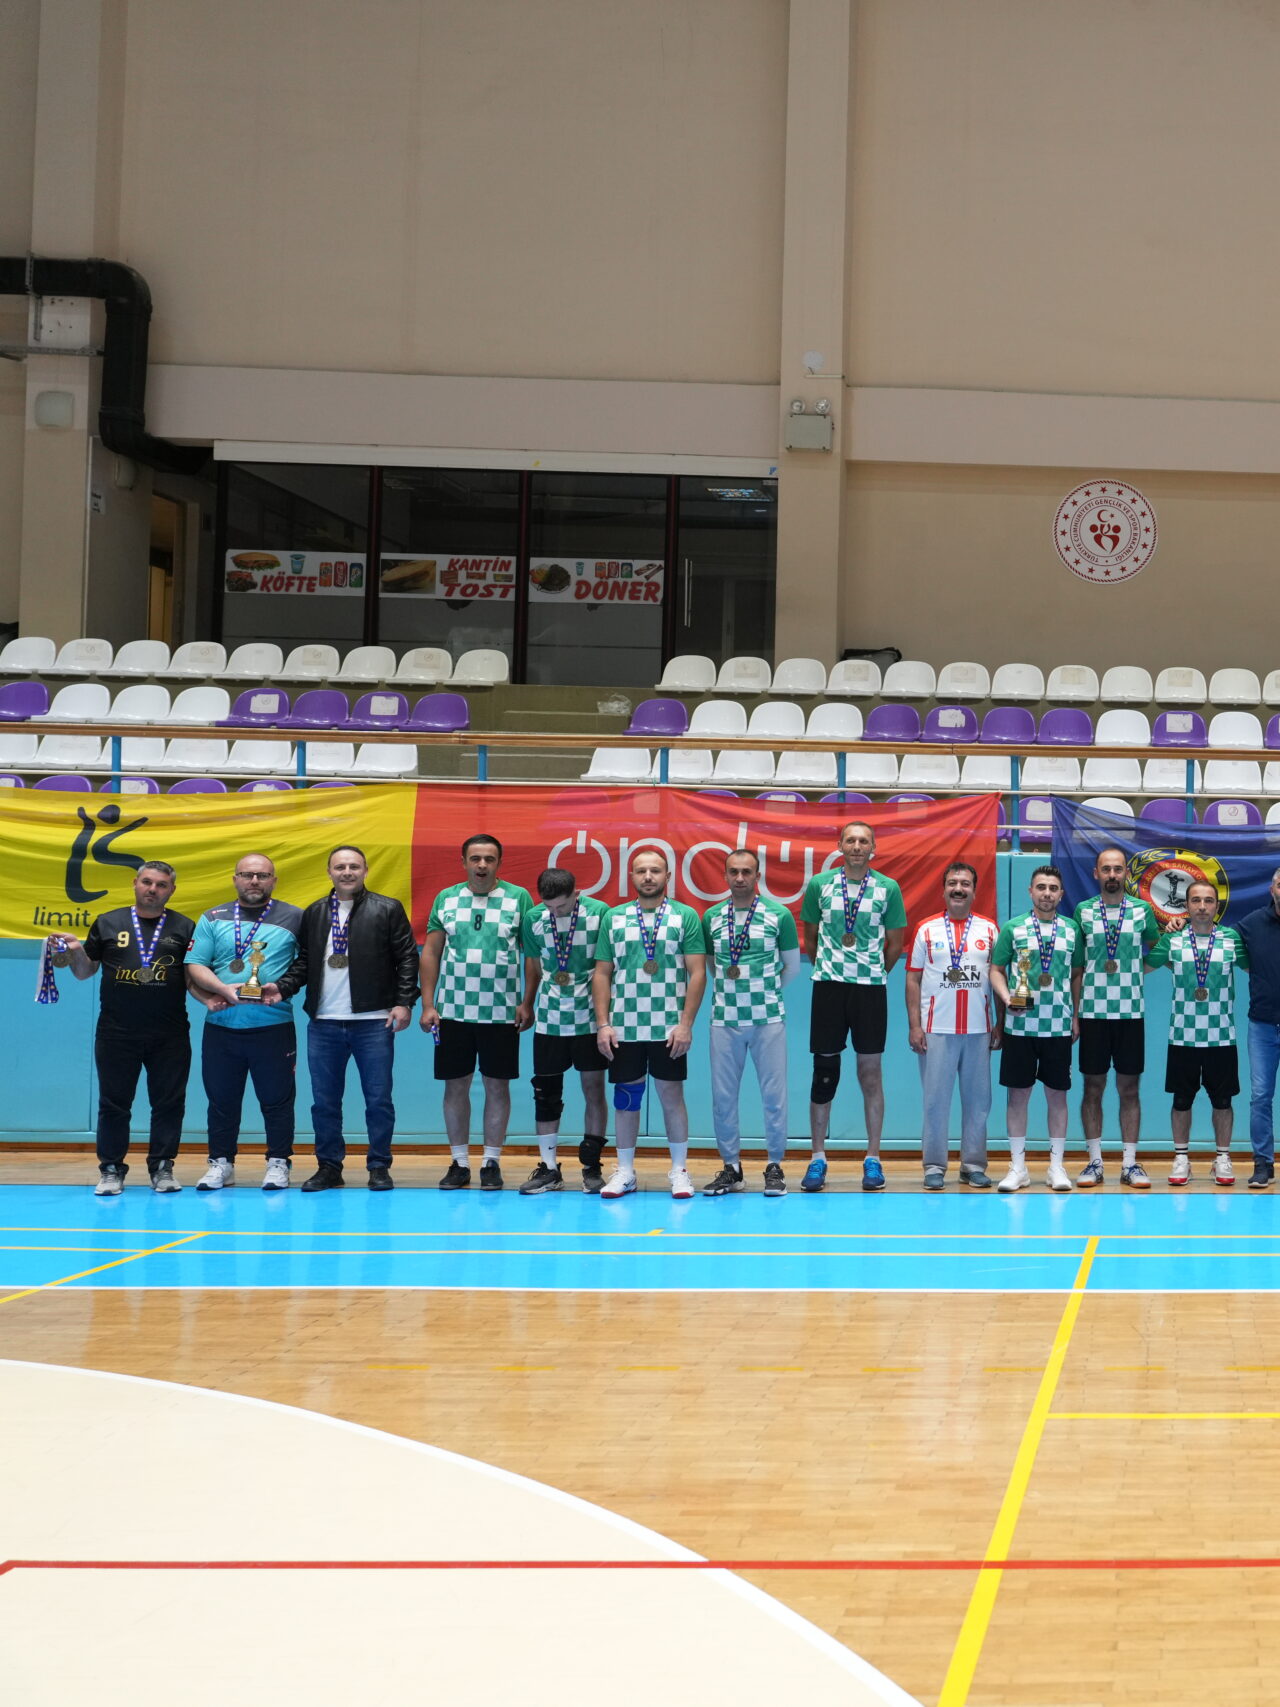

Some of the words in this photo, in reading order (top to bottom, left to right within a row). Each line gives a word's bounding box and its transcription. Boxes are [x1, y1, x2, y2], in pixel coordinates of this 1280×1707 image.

[447, 557, 513, 572] KANTİN
[260, 571, 318, 593] KÖFTE
[443, 583, 516, 598] TOST
[574, 575, 660, 603] DÖNER
[33, 906, 91, 927] limit
[473, 914, 482, 931] 8
[117, 931, 130, 947] 9
